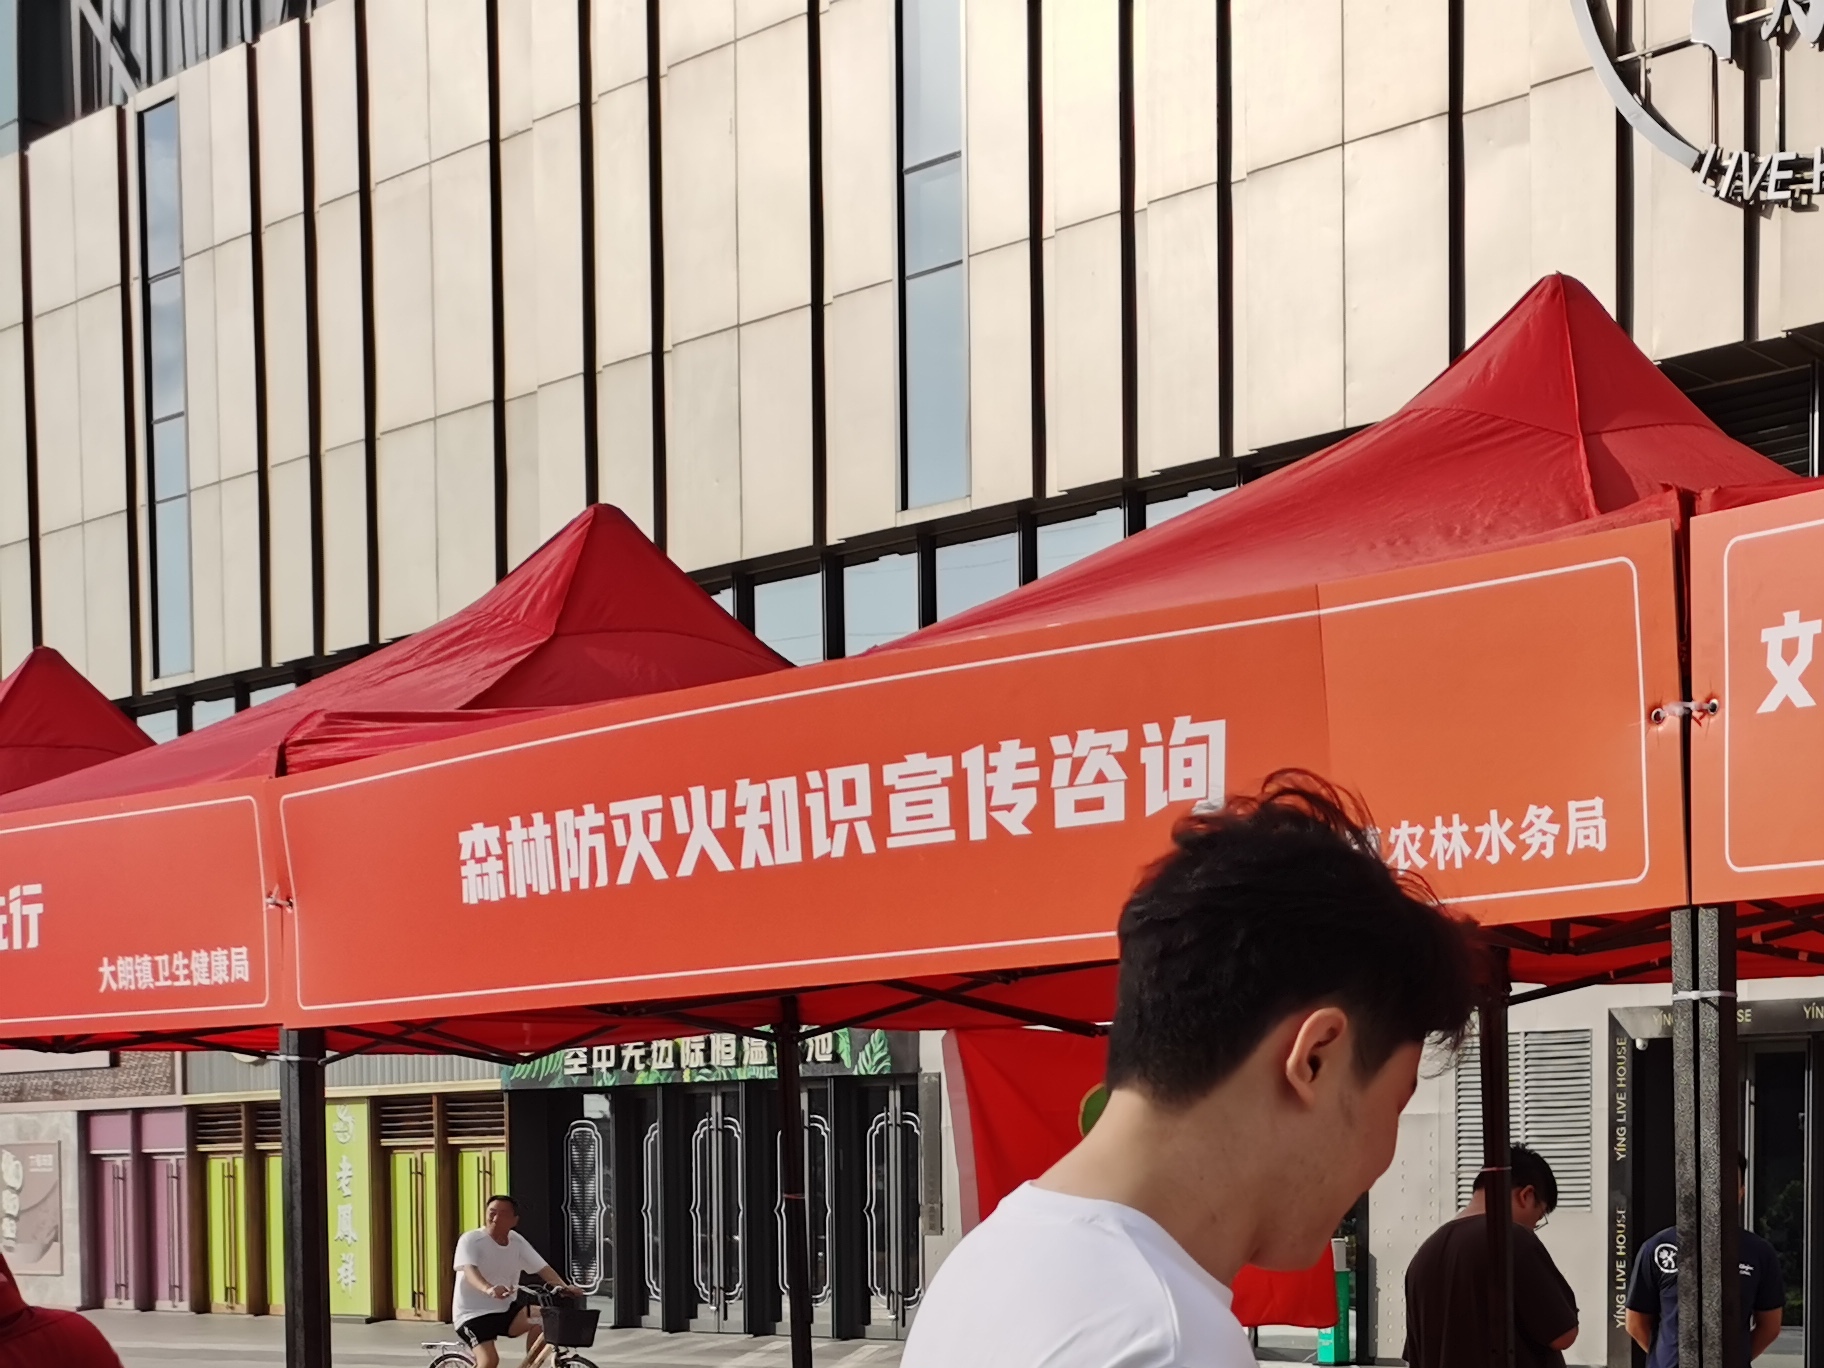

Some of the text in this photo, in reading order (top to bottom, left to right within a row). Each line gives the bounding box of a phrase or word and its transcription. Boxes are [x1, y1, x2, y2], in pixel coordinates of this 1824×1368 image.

[1699, 143, 1796, 200] LIVE
[459, 715, 1226, 904] 森林防灭火知识宣传咨询
[1345, 796, 1607, 875] 农林水务局
[98, 945, 249, 993] 大朗镇卫生健康局
[563, 1032, 834, 1076] 空中无边际恒温池
[1616, 1036, 1628, 1088] HOUSE
[1616, 1091, 1628, 1123] LIVE
[1615, 1257, 1627, 1290] LIVE
